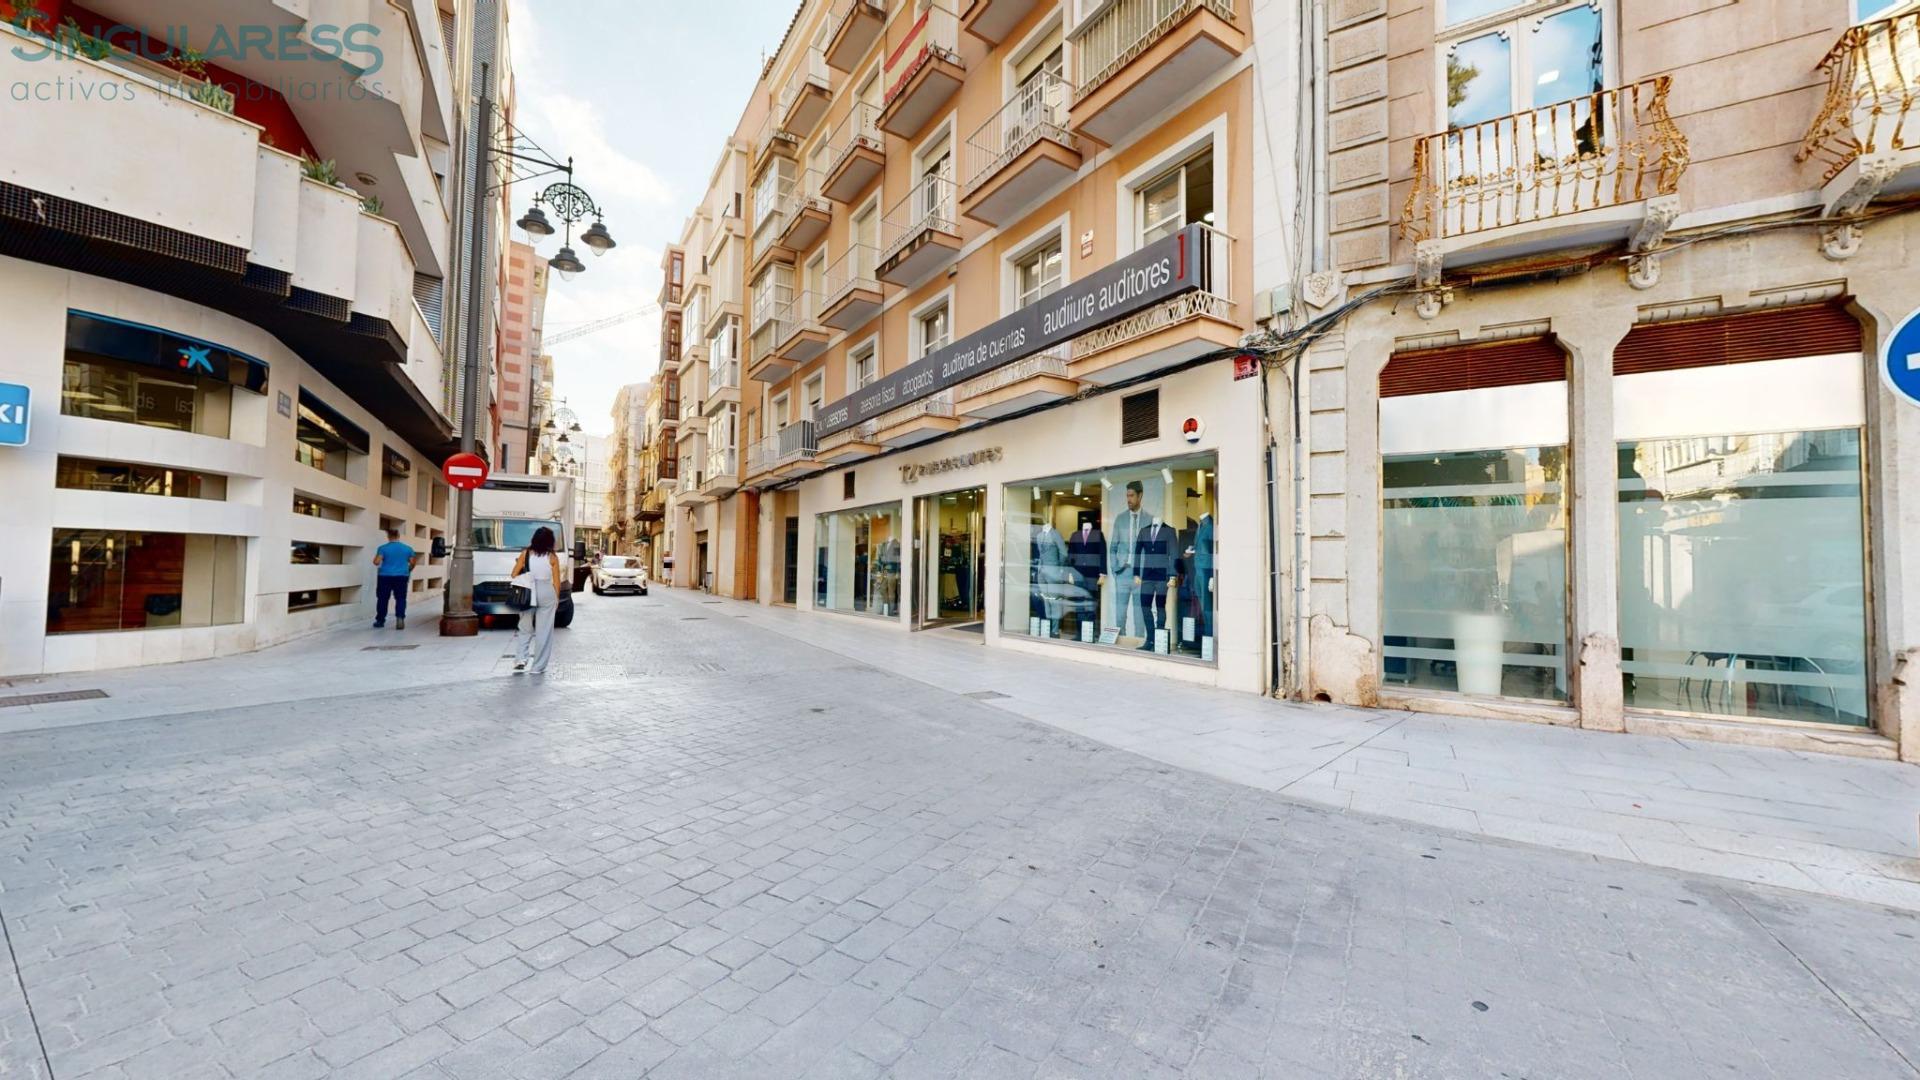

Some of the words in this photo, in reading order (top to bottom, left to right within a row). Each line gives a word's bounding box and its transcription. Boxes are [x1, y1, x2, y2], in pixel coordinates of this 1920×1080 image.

[902, 368, 934, 396] abogados
[976, 341, 988, 364] de
[989, 327, 1026, 358] cuentas
[1043, 294, 1095, 335] audiiure
[1099, 257, 1170, 312] auditores
